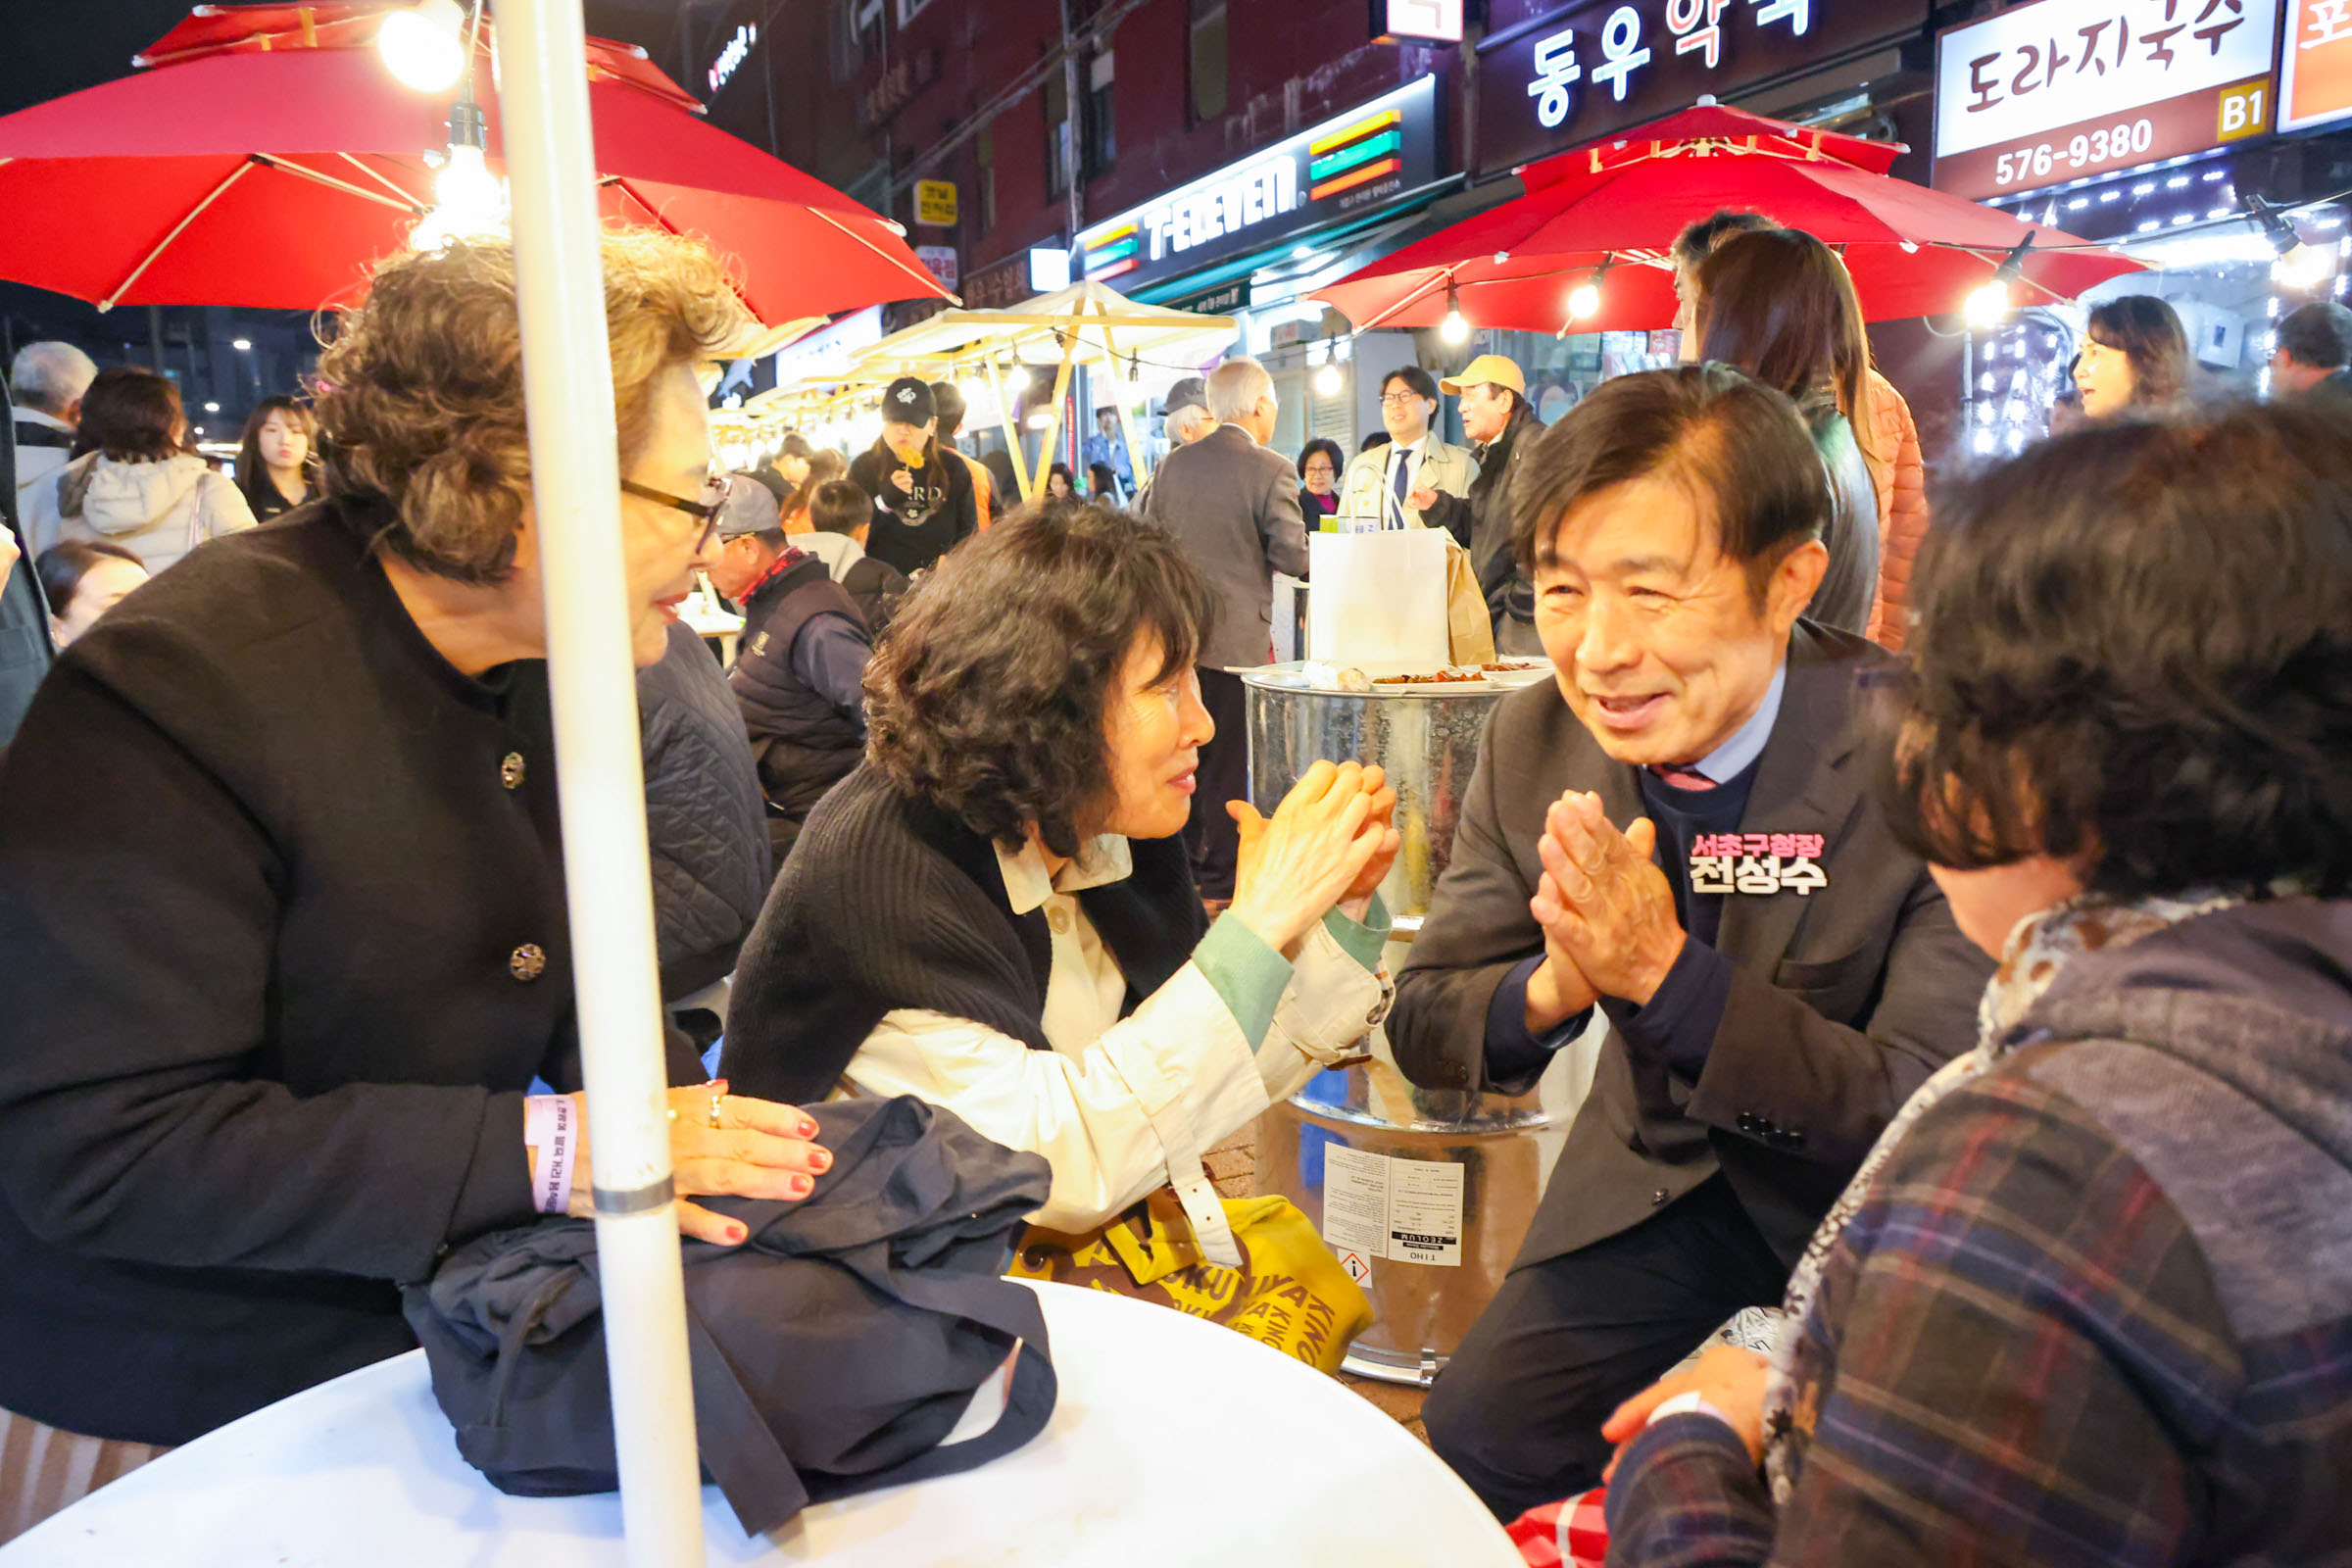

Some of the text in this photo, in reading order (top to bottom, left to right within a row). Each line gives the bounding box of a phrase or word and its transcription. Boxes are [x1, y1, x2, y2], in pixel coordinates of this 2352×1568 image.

[2221, 89, 2263, 132] B1
[1994, 118, 2153, 185] 576-9380
[907, 486, 947, 502] RD.
[1690, 833, 1825, 858] 서초구청장
[1689, 855, 1828, 896] 전성수
[1401, 1233, 1444, 1245] ZEOLUM
